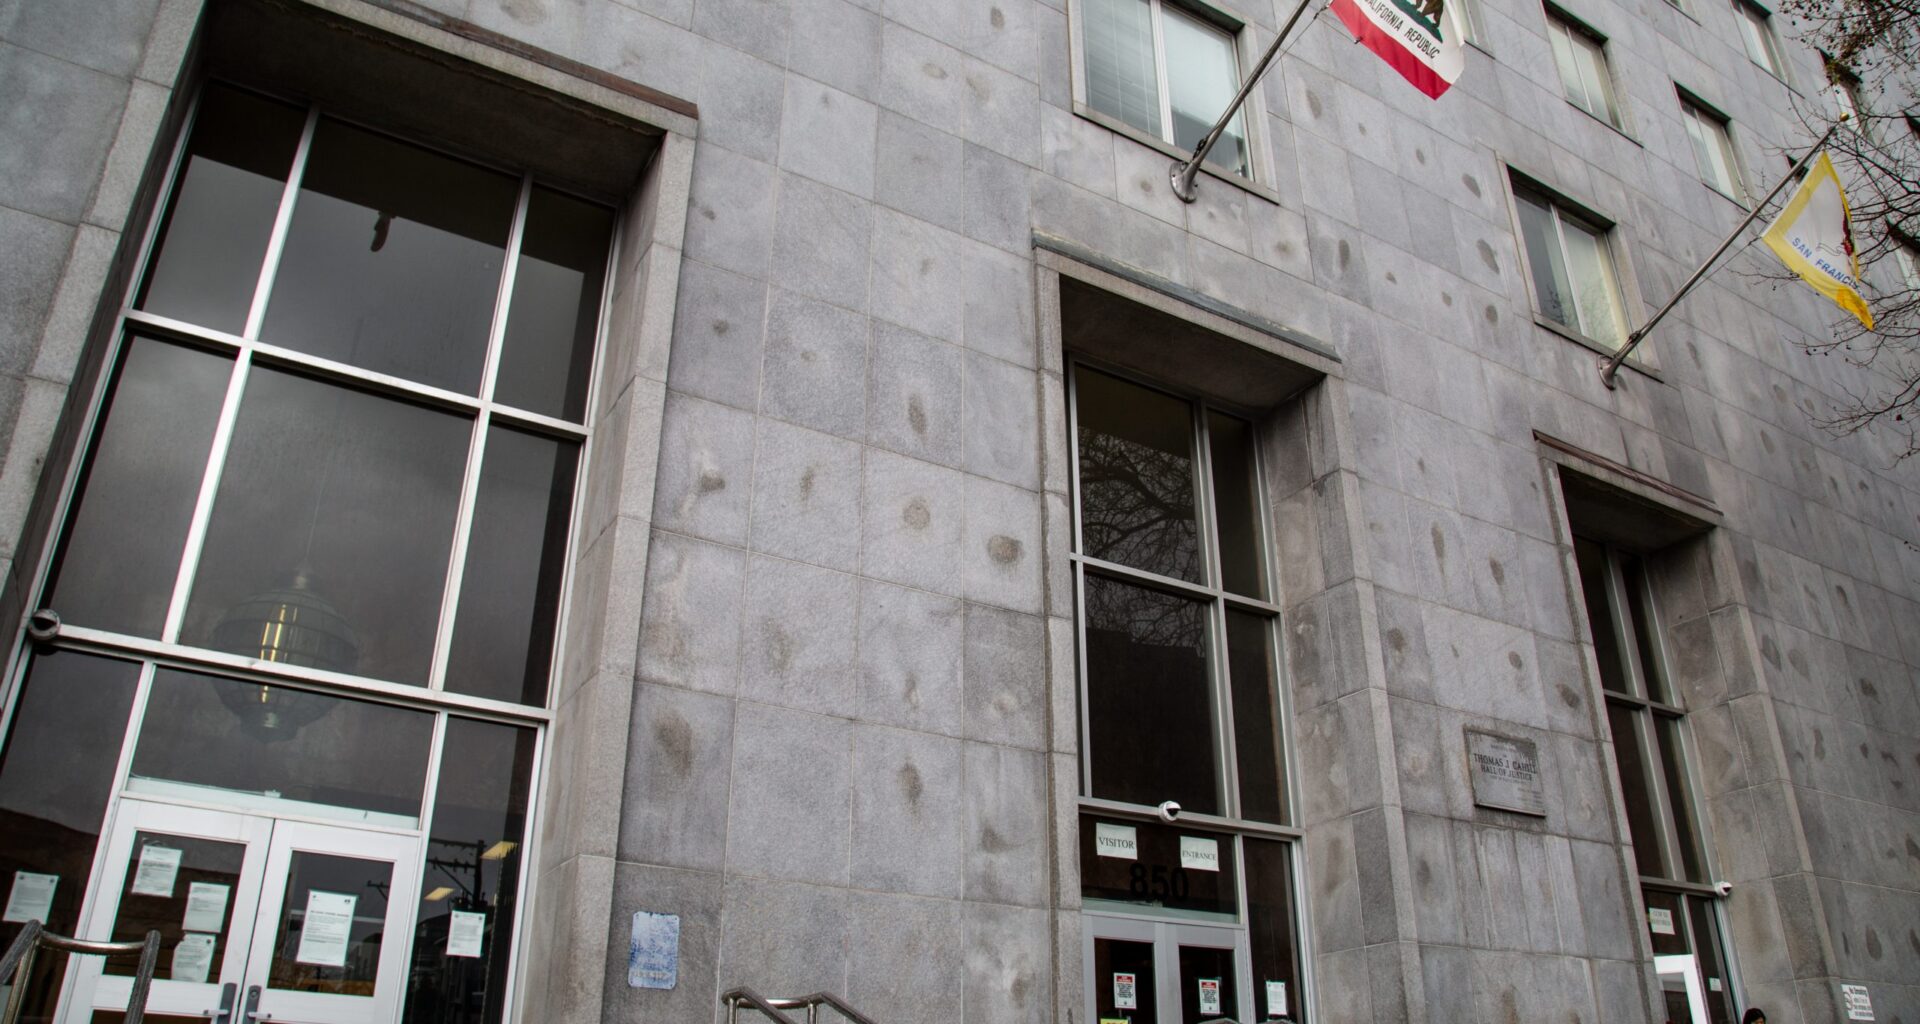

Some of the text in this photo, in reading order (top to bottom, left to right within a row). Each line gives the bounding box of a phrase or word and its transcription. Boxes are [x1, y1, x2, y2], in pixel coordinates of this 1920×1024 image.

[1404, 28, 1440, 59] REPUBLIC
[1792, 237, 1812, 258] SAN
[1473, 753, 1504, 767] THOMAS
[1480, 764, 1497, 775] HALL
[1498, 767, 1506, 776] OF
[1508, 770, 1532, 781] JUSTICE
[1098, 837, 1135, 849] VISITOR
[1182, 850, 1216, 861] ENTRANCE
[1130, 863, 1188, 899] 850
